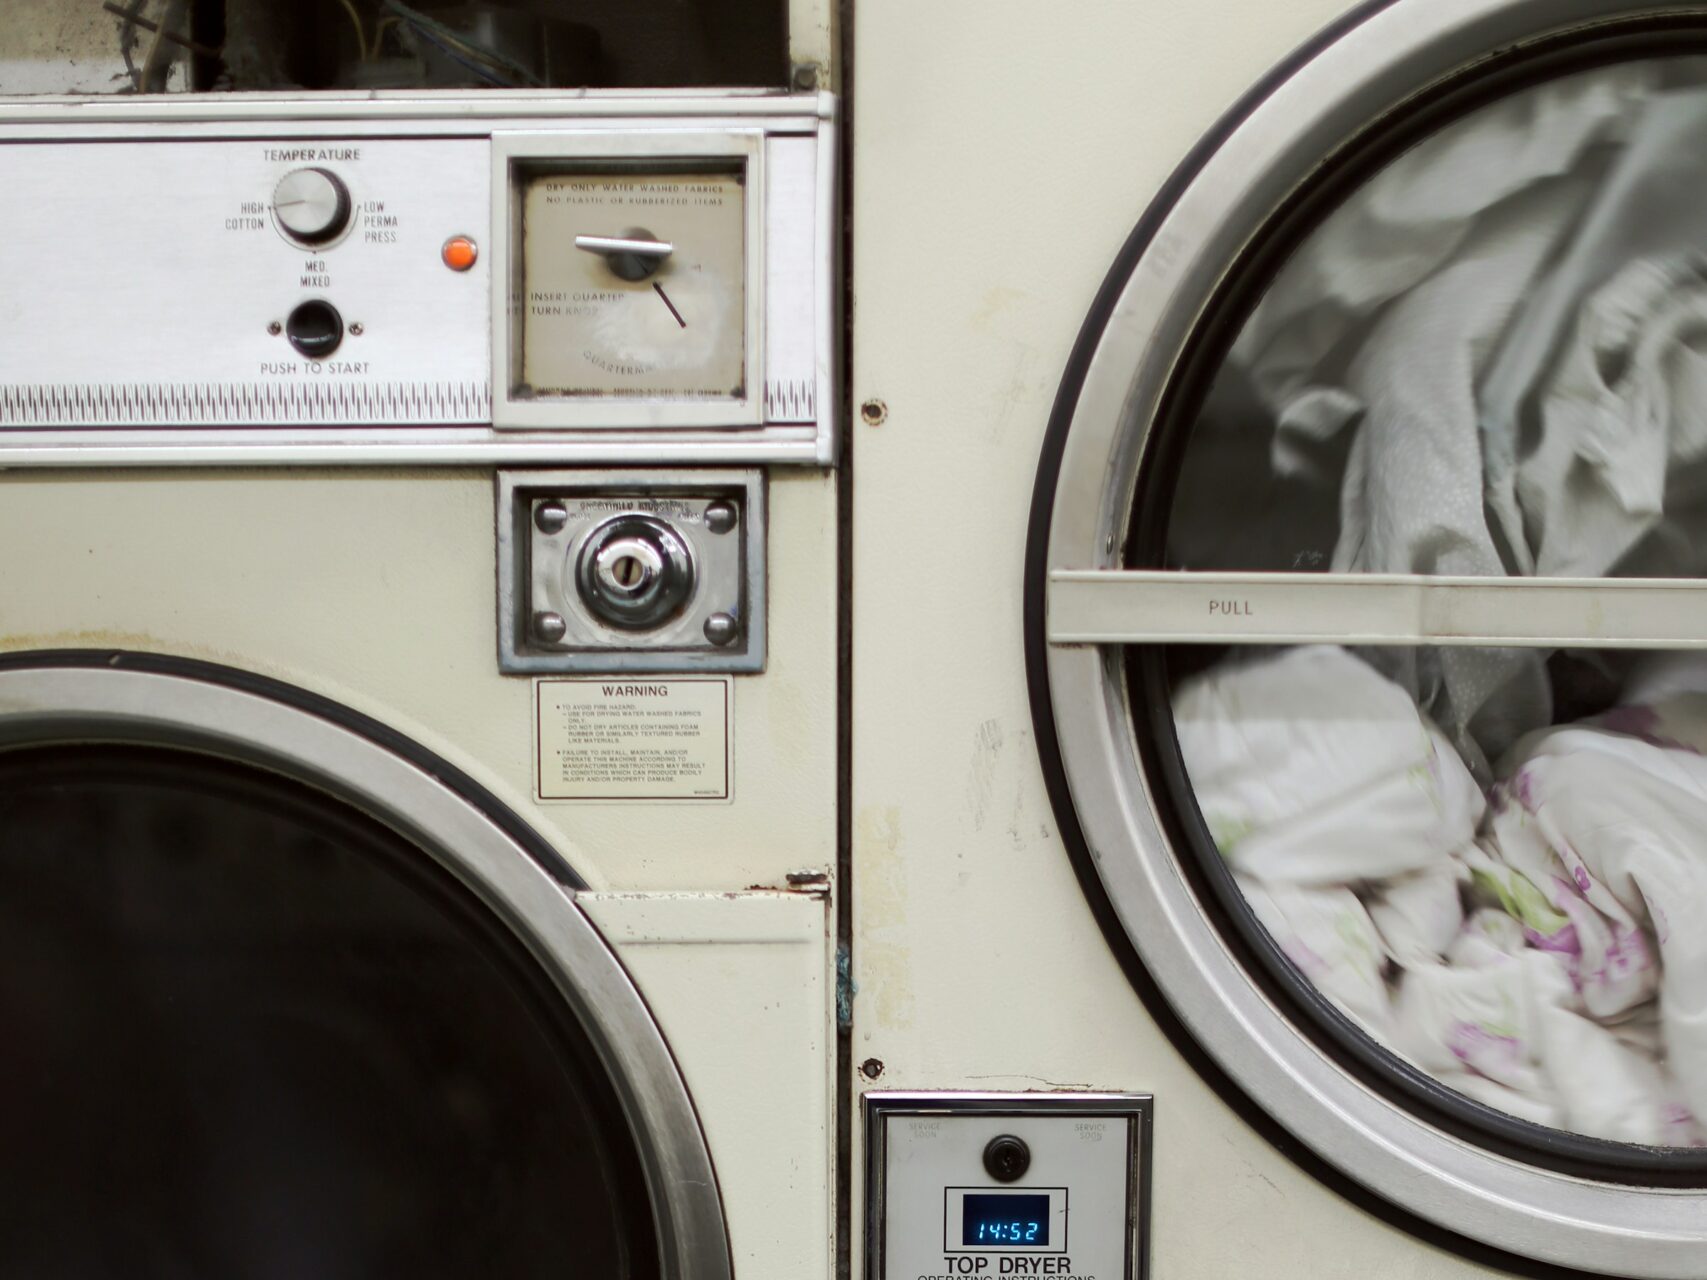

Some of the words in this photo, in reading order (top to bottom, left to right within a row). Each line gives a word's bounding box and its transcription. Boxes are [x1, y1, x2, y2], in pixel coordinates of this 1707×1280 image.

[264, 150, 360, 161] TEMPERATURE
[602, 184, 633, 192] WATER
[241, 202, 264, 213] HIGH
[364, 201, 384, 212] LOW
[225, 219, 264, 230] COTTON
[364, 216, 397, 227] PERMA
[365, 231, 396, 243] PRESS
[300, 276, 330, 287] MIXED
[532, 306, 560, 315] TURN
[261, 362, 296, 374] PUSH
[304, 362, 321, 373] TO
[329, 362, 369, 373] START
[1210, 600, 1253, 615] PULL
[602, 686, 668, 696] WARNING
[979, 1222, 1038, 1240] 14:52
[944, 1257, 988, 1274] TOP
[1000, 1258, 1070, 1274] DRYER
